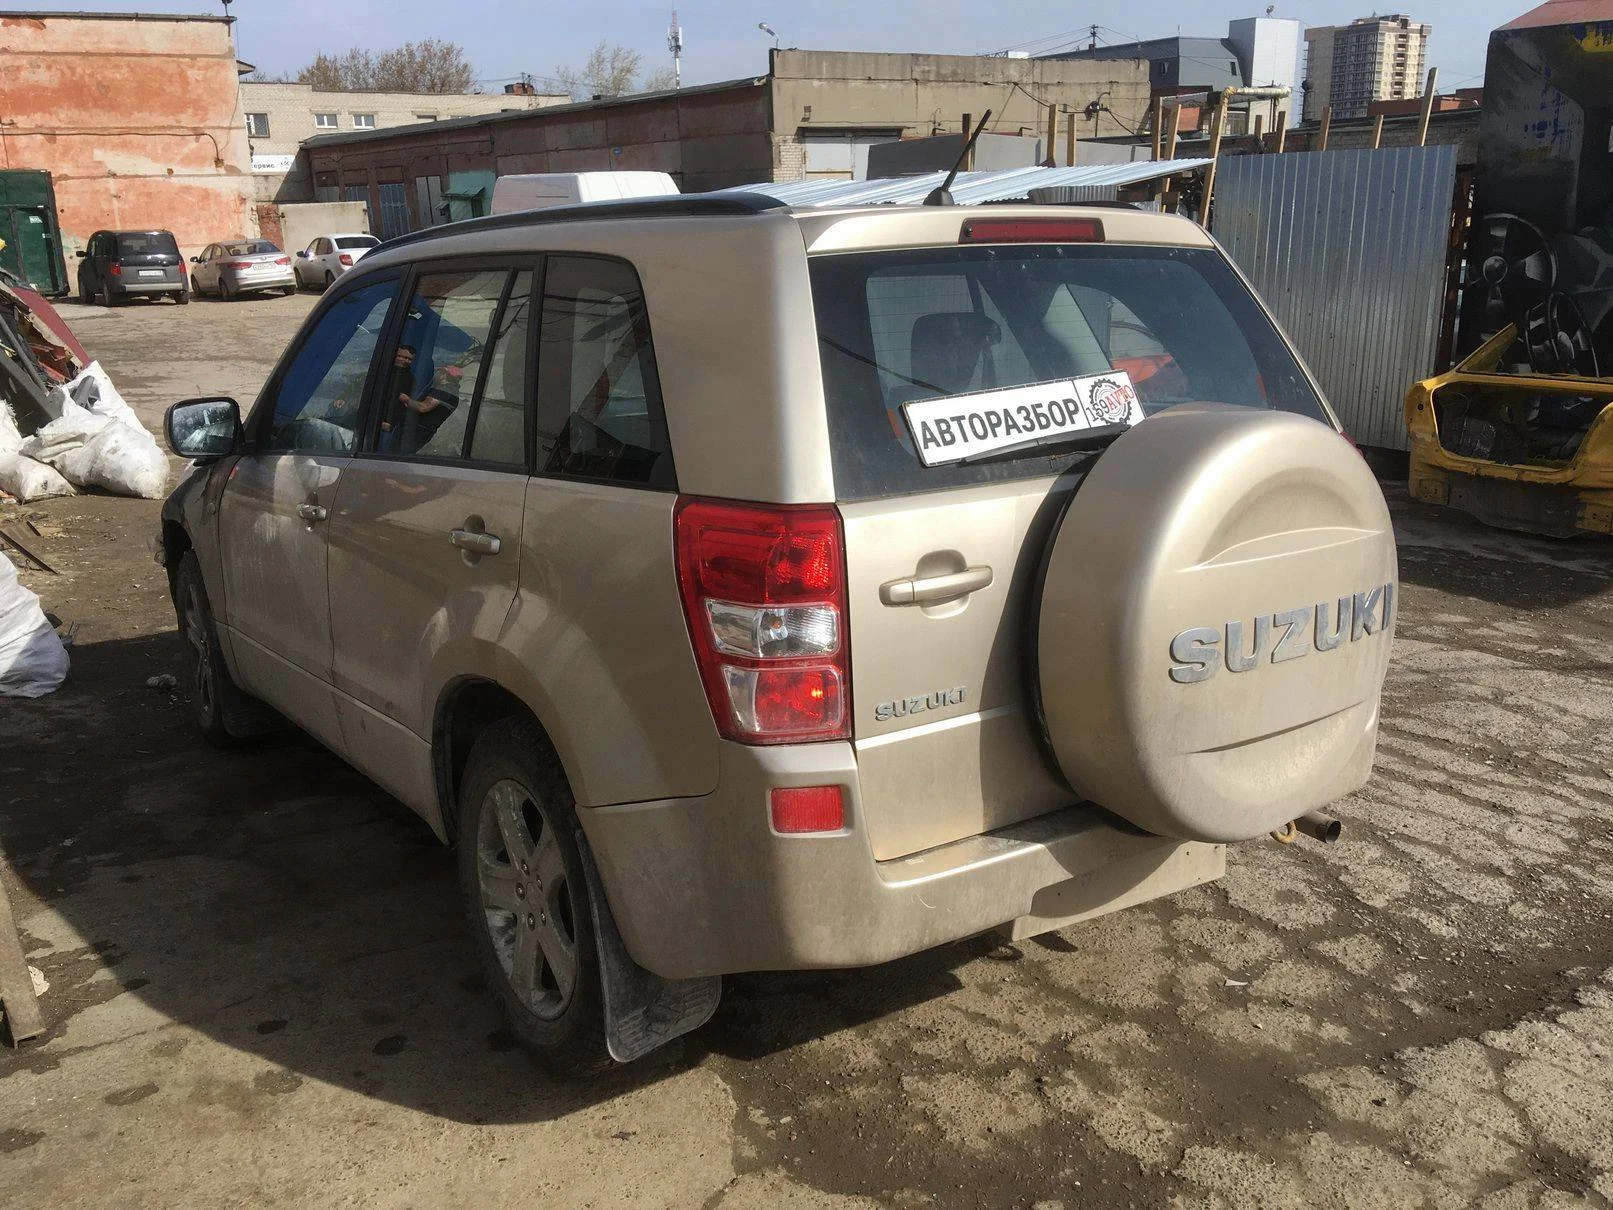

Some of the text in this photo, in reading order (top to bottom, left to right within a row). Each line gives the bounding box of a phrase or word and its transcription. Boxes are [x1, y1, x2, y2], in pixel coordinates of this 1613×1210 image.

[921, 398, 1080, 450] АВТОРАЗБОР
[1168, 582, 1394, 684] SUZUKI
[875, 686, 966, 721] SUZUKI
